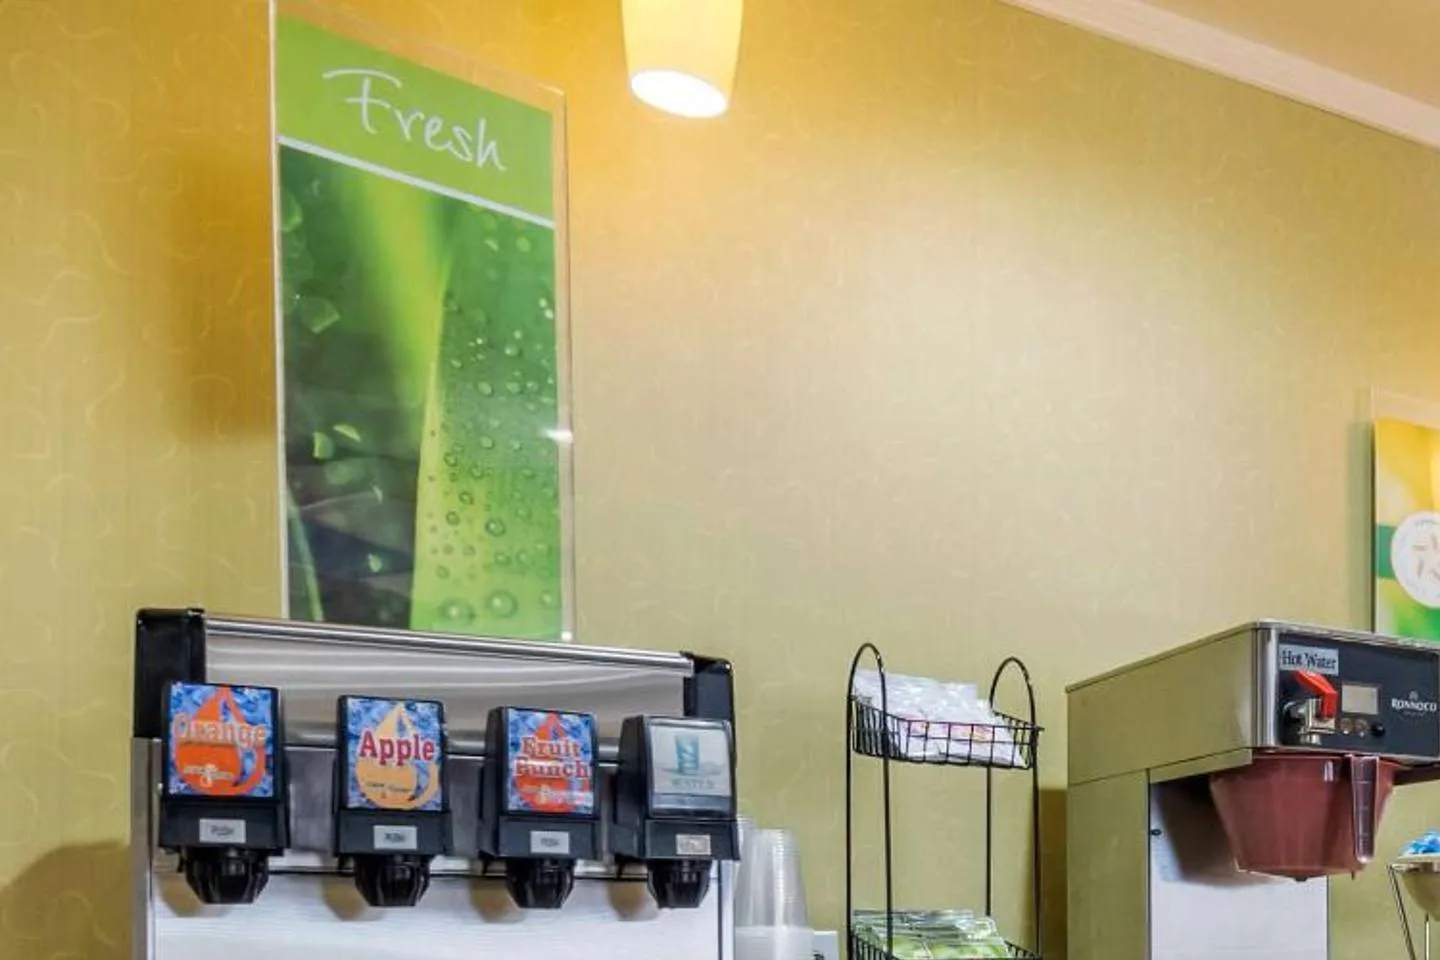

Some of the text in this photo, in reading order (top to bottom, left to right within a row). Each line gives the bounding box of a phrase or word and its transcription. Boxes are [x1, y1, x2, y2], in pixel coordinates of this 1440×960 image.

[321, 67, 507, 172] Fresh
[1281, 650, 1337, 669] Hot Water
[173, 714, 266, 748] Orange
[358, 730, 435, 767] Apple
[521, 736, 581, 759] Fruit
[514, 757, 590, 778] Punch
